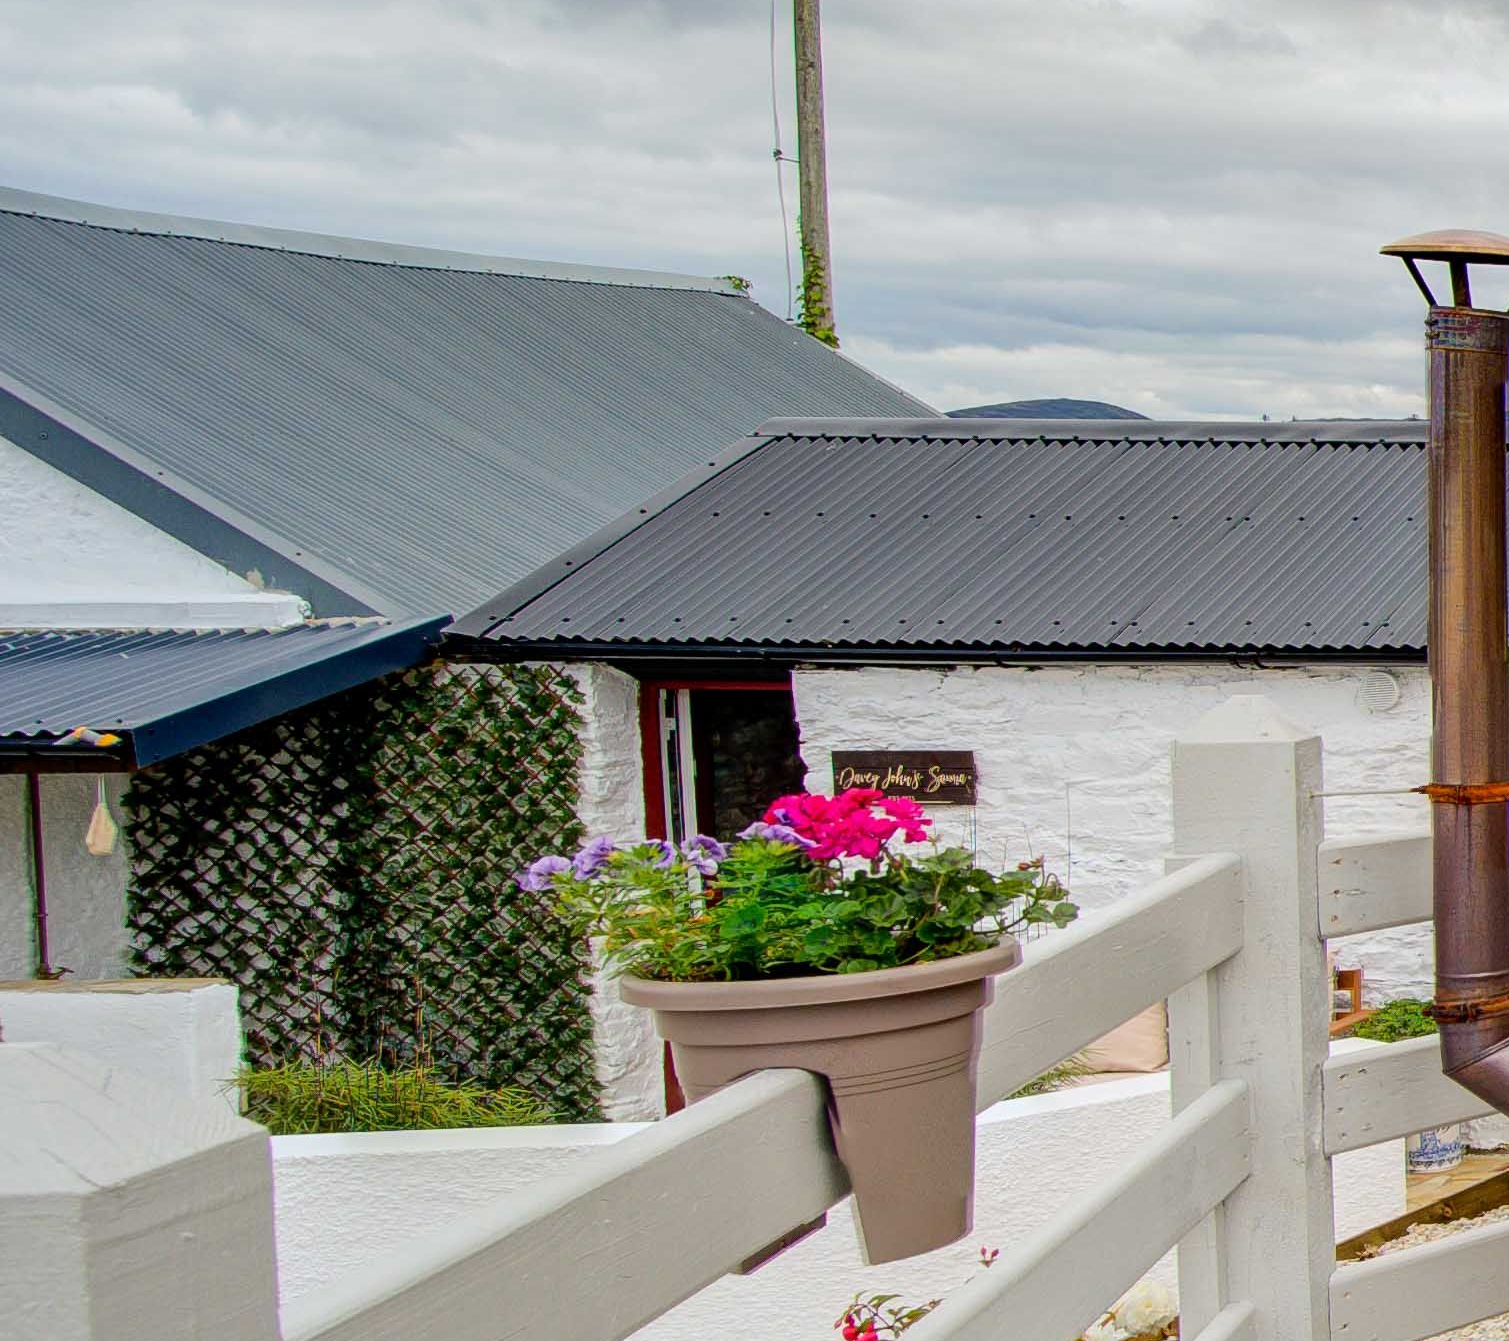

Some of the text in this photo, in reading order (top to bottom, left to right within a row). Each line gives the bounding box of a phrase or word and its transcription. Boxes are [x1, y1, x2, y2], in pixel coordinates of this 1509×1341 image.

[838, 764, 968, 793] Davey John's Sauna
